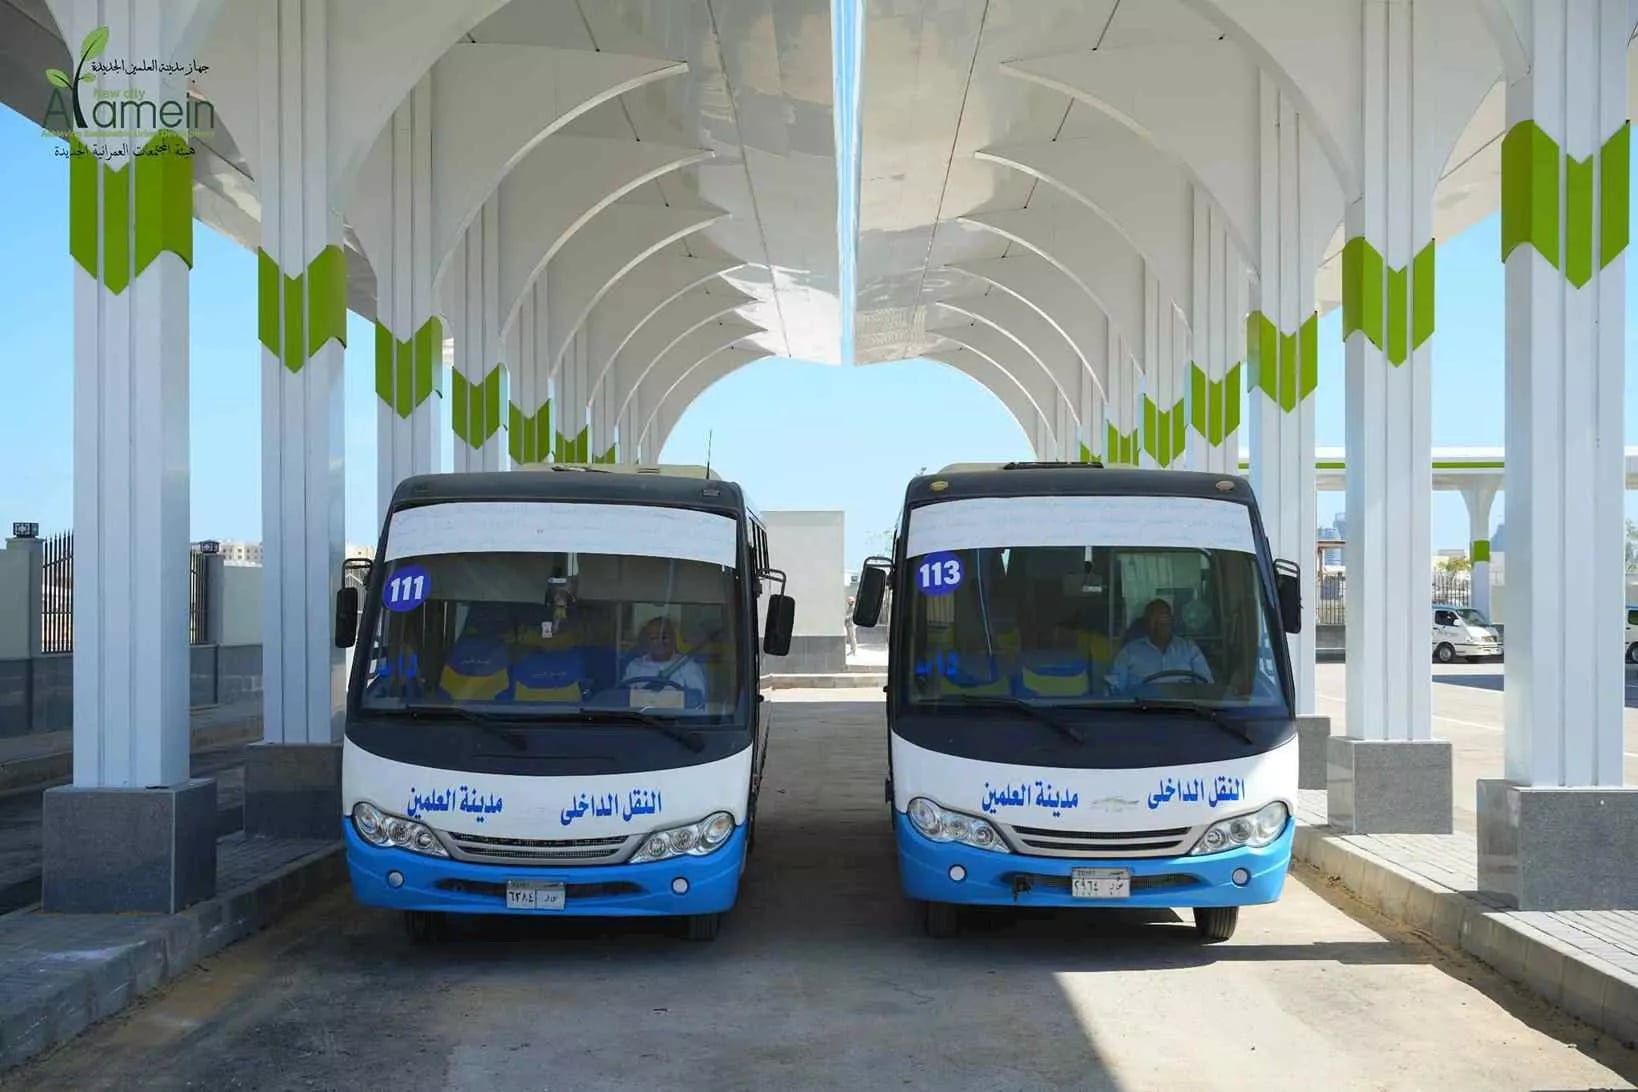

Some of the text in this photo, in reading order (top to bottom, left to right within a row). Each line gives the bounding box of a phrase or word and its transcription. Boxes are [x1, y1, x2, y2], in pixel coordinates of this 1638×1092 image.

[391, 575, 424, 602] 111
[920, 560, 960, 588] 113
[407, 785, 503, 823] مدينة العلمين
[622, 788, 662, 822] النقل
[981, 780, 1079, 817] مدينة العلمين
[1208, 776, 1245, 808] النقل
